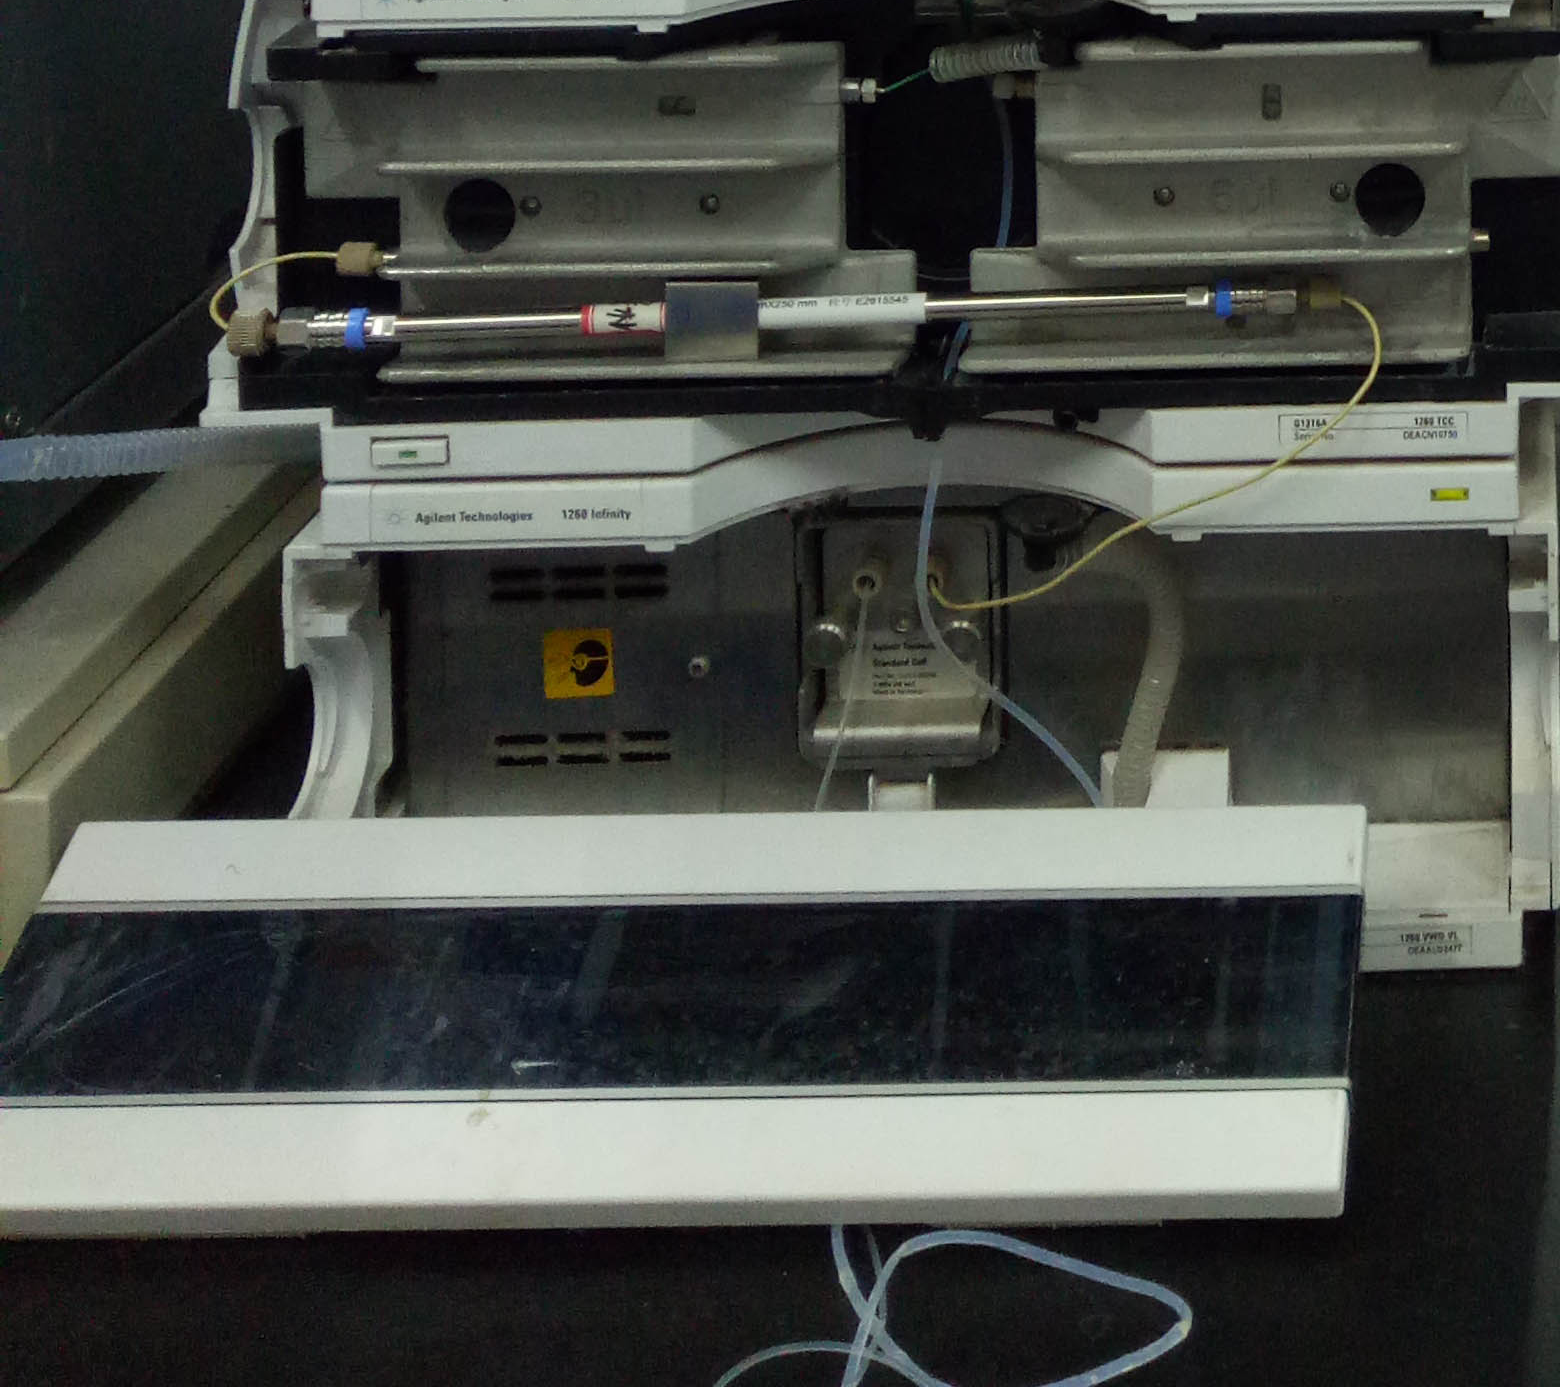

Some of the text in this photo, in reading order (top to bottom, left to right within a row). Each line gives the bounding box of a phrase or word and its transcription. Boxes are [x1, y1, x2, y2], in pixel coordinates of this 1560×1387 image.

[415, 510, 533, 525] Agilent Technologies
[591, 508, 631, 521] Infinity
